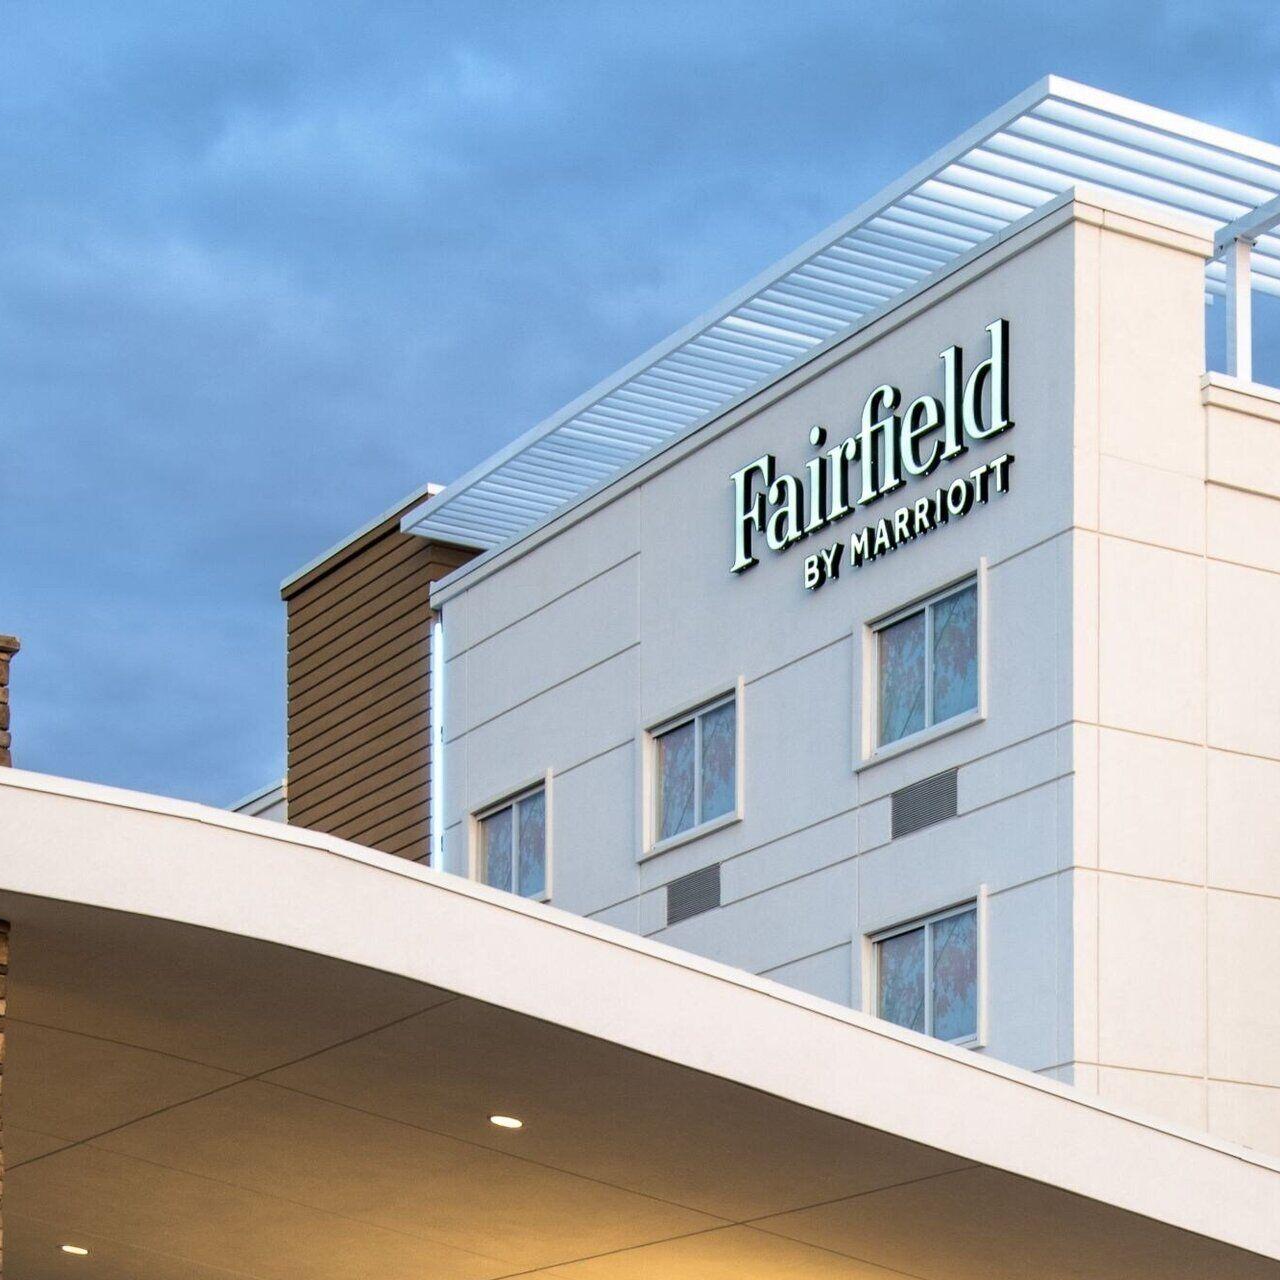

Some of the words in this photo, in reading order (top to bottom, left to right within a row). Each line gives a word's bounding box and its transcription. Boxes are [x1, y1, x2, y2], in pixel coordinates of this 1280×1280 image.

[730, 317, 1015, 573] Fairfield
[804, 542, 845, 590] BY
[851, 453, 1015, 567] MARRIOTT
